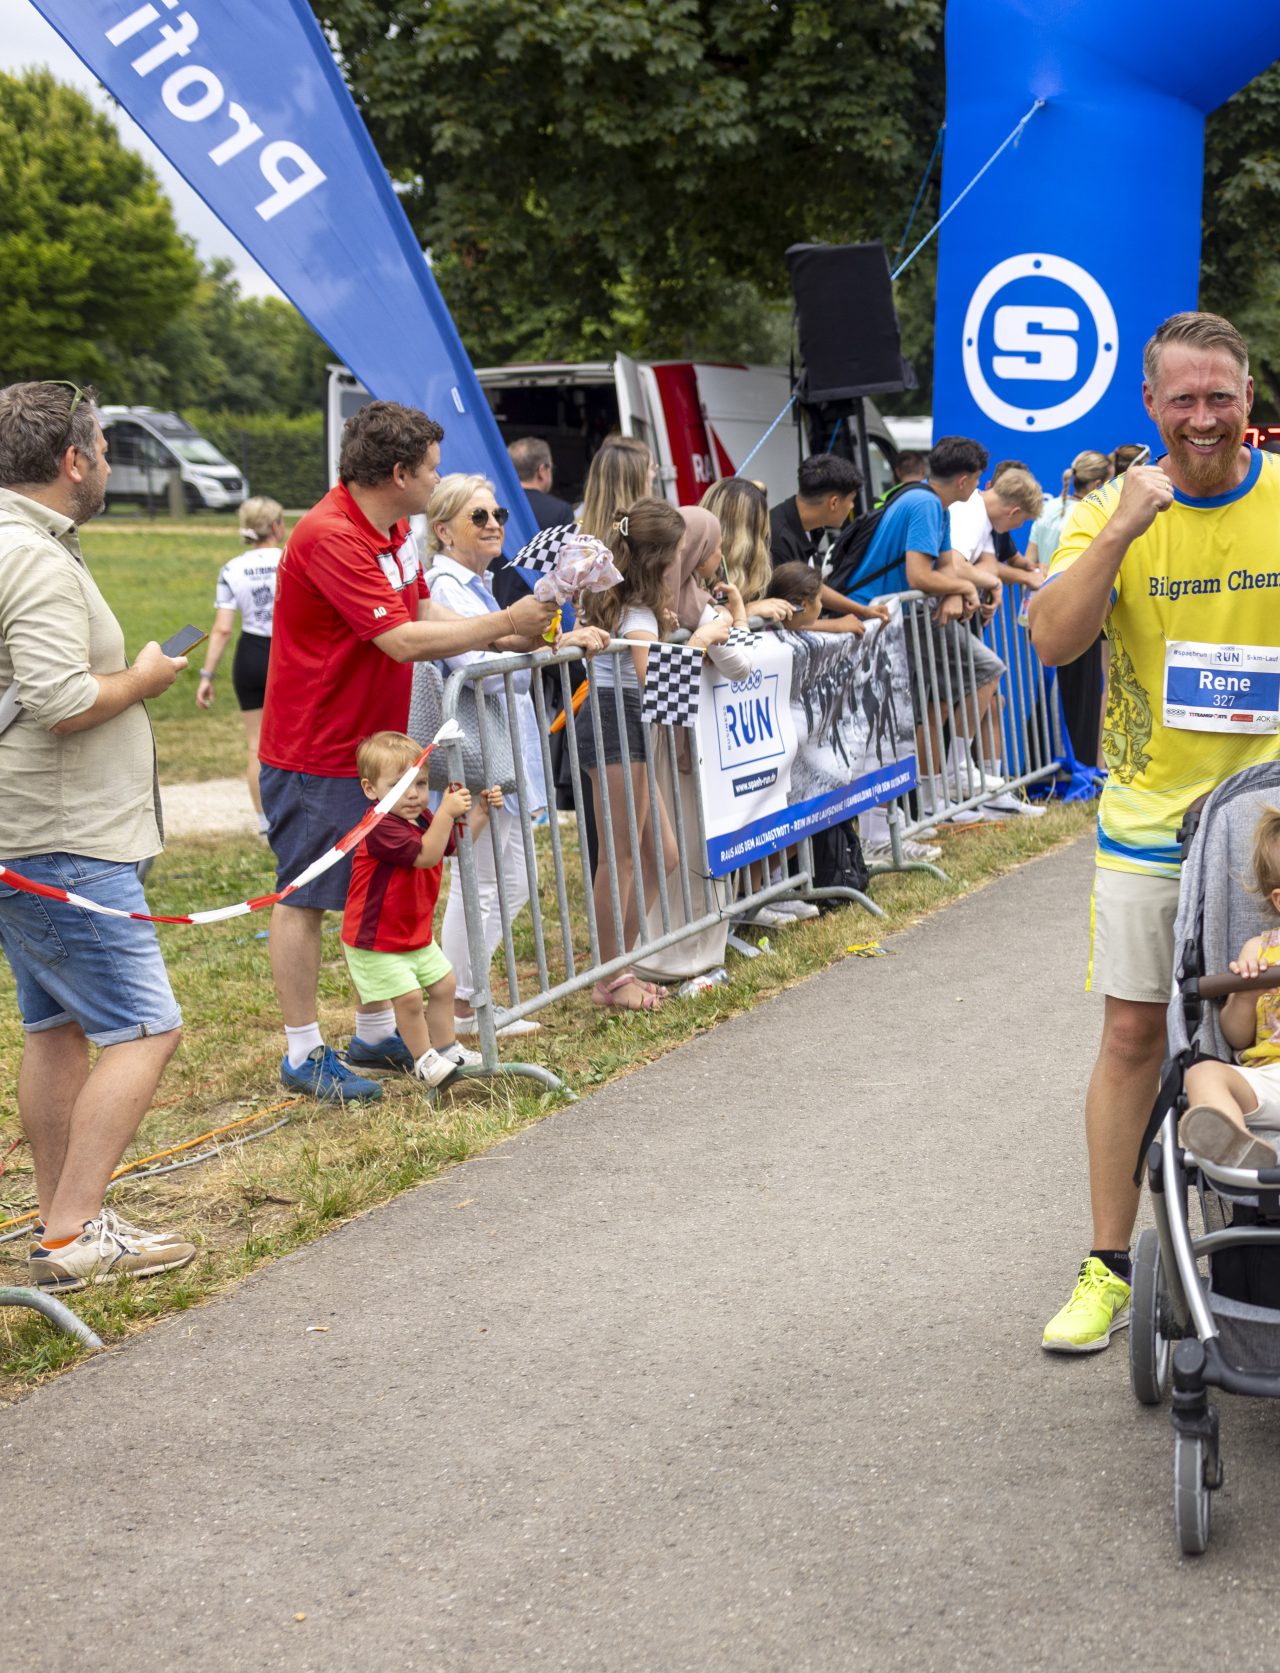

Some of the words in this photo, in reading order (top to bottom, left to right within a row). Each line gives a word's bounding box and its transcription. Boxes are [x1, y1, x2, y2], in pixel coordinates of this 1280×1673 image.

[1149, 576, 1221, 601] Bilgram
[1214, 651, 1240, 663] RUN
[1199, 670, 1251, 692] Rene
[1213, 694, 1236, 707] 327
[726, 696, 774, 748] RUN
[720, 847, 734, 862] RAUS
[735, 842, 745, 856] AUS
[744, 837, 755, 852] DEM
